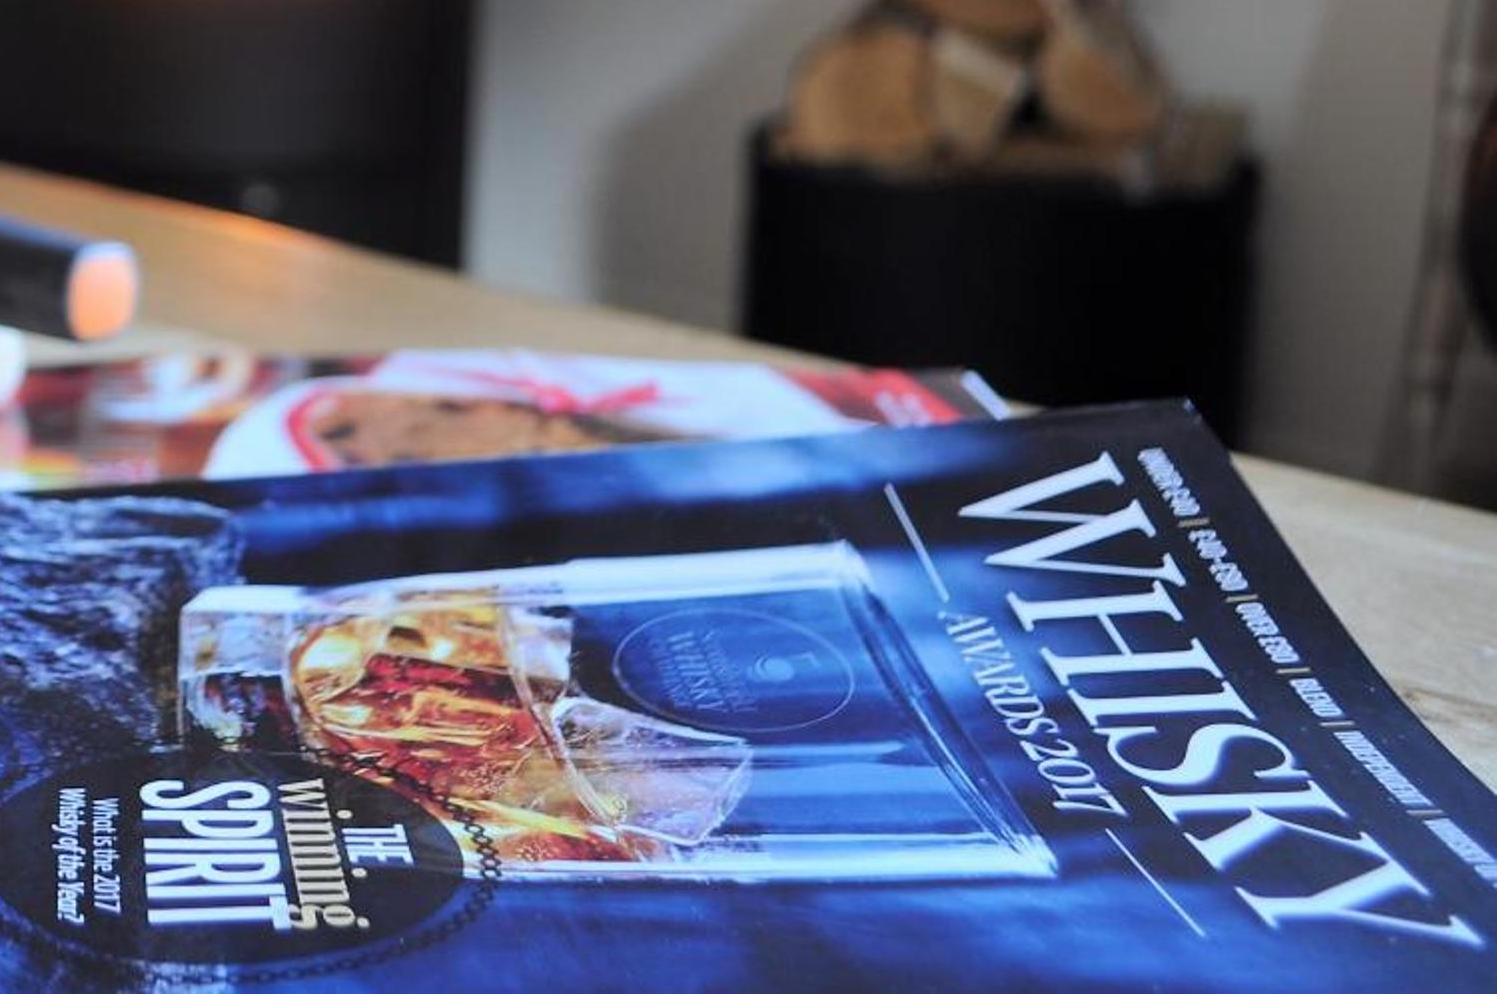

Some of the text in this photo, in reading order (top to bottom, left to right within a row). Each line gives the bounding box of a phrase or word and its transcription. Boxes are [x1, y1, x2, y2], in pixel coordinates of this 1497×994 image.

[938, 611, 1129, 817] AWARDS 2017
[957, 451, 1485, 950] WHISKY
[1235, 602, 1279, 637] OVER
[1289, 677, 1346, 718] BLEND
[52, 787, 87, 926] Whisky of the Year?
[93, 797, 122, 914] What is the 2017
[139, 779, 292, 931] SPIRIT
[278, 778, 370, 931] winning
[341, 823, 415, 867] THE
